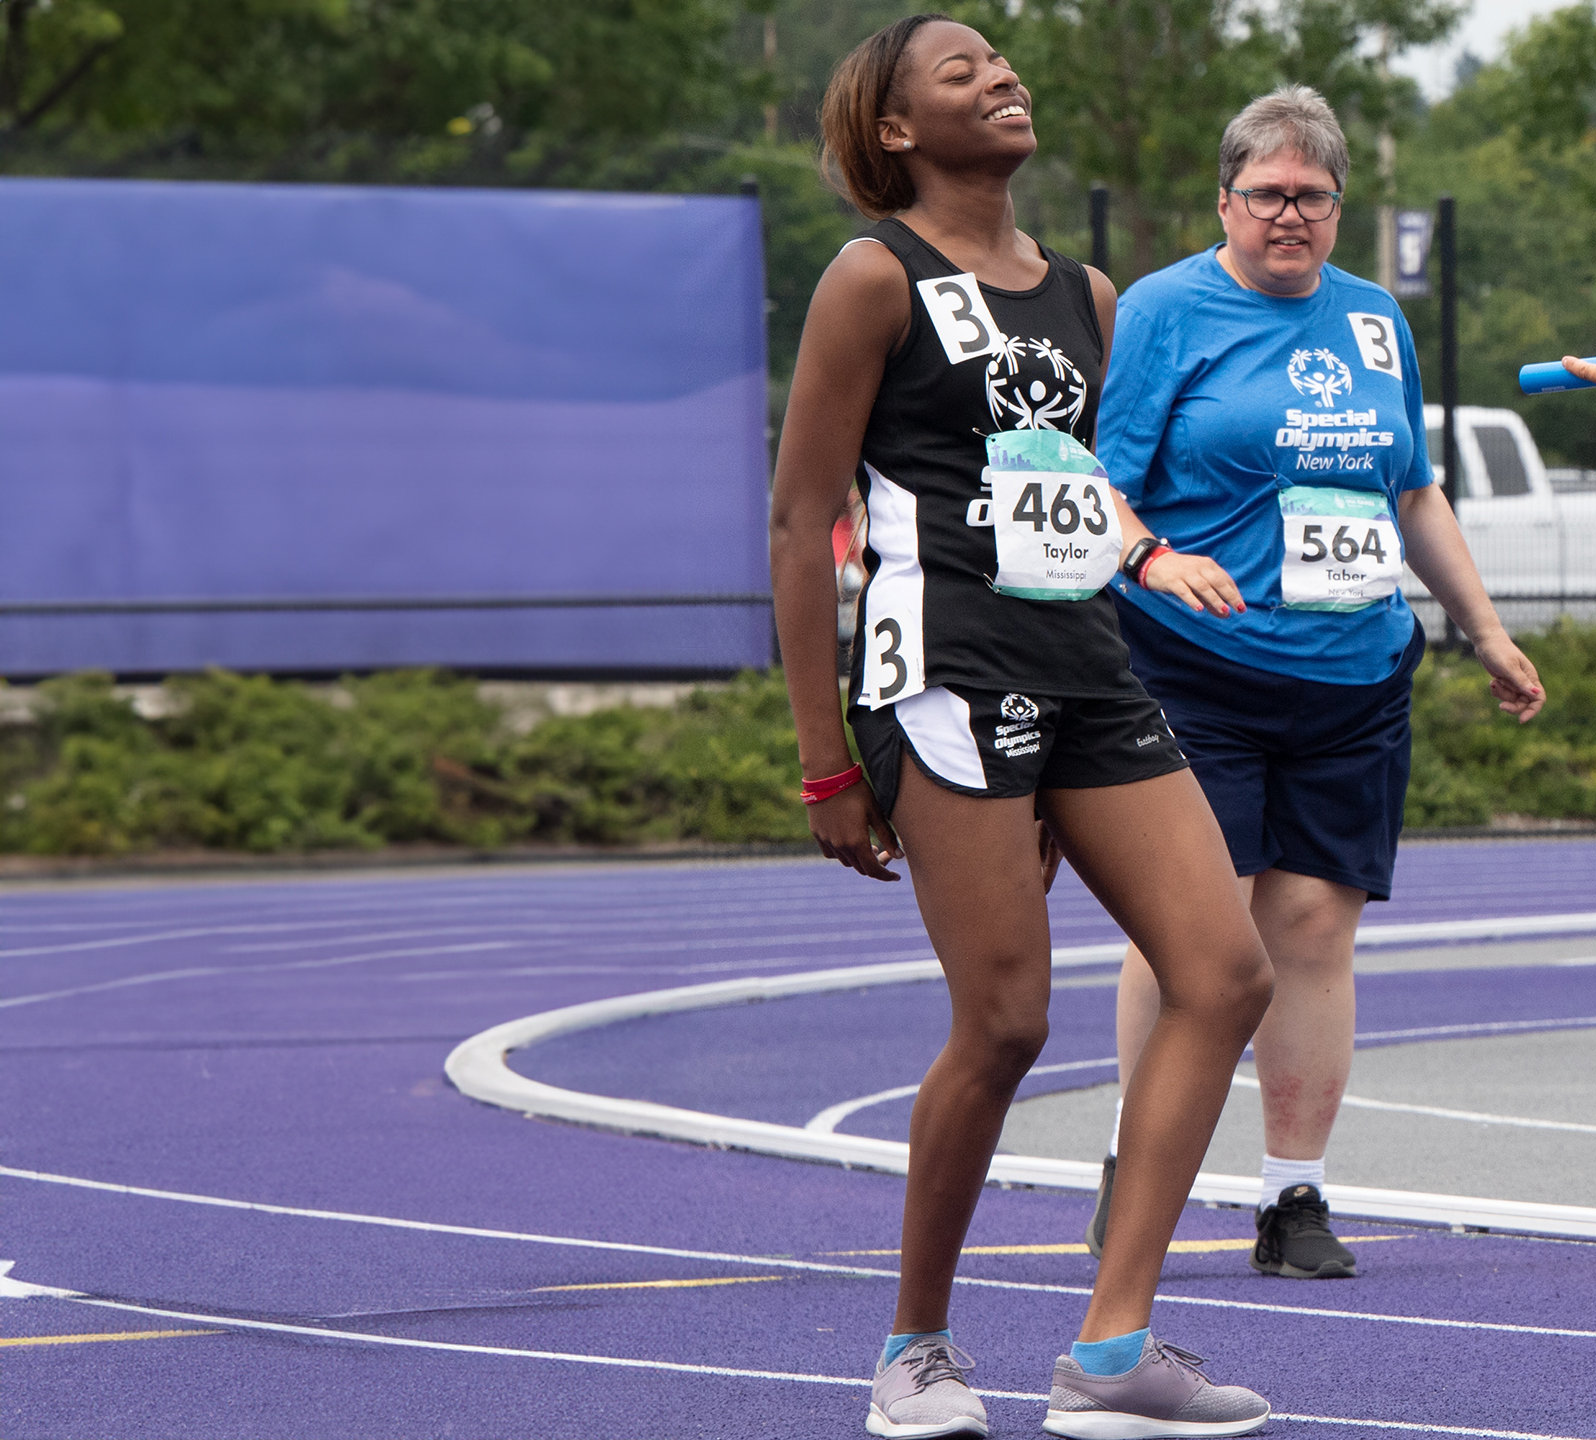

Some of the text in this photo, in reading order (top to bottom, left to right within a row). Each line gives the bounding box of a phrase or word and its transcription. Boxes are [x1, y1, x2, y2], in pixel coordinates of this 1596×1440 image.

[934, 281, 991, 354] 3
[1361, 317, 1394, 371] 3
[1285, 408, 1377, 431] Special
[1275, 427, 1395, 452] Olympics
[1296, 452, 1375, 470] New York
[1012, 482, 1108, 536] 463
[1043, 542, 1090, 563] Taylor
[1300, 524, 1388, 564] 564
[1045, 568, 1087, 582] Mississippi
[1325, 568, 1368, 582] Taber
[874, 617, 909, 701] 3
[994, 730, 1042, 749] Olympics
[1005, 741, 1041, 758] Mississippi
